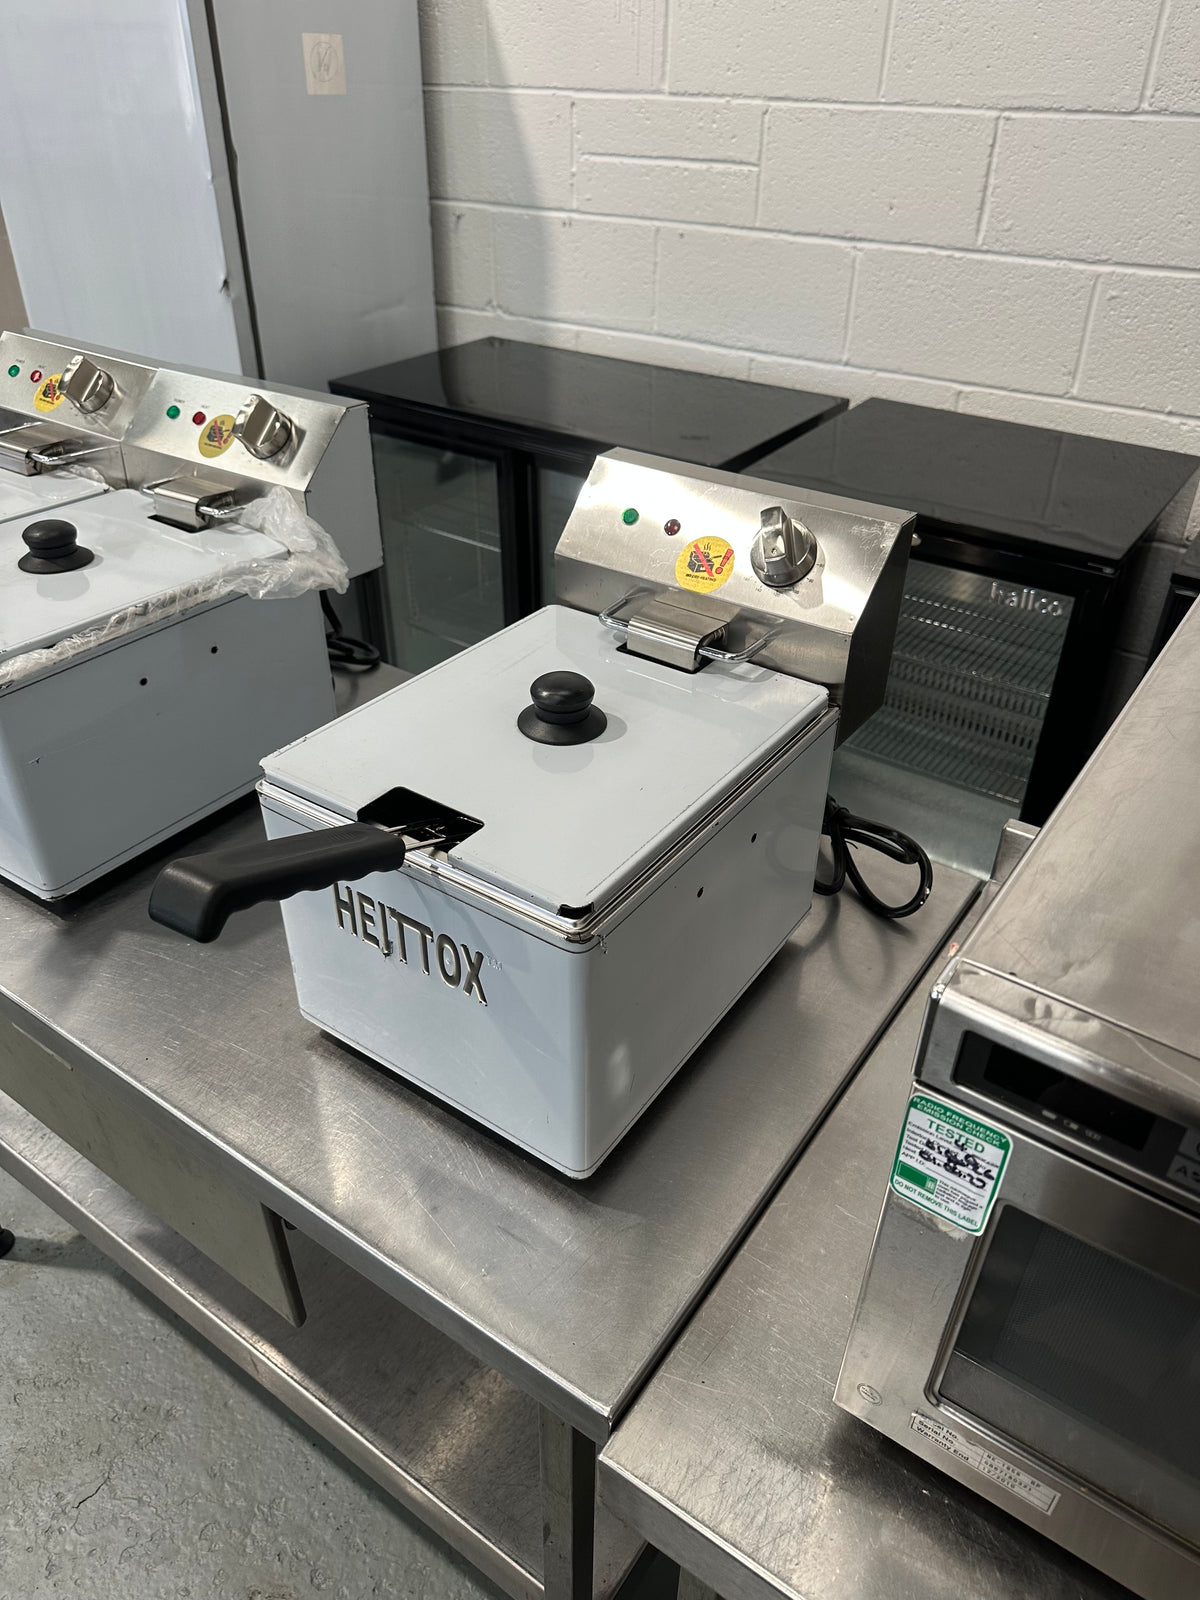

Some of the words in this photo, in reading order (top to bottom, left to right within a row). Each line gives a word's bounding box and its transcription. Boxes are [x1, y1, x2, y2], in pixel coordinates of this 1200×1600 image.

[913, 1096, 945, 1113] RADIO
[946, 1111, 1008, 1143] FREQUENCY
[916, 1104, 963, 1129] EMISSION
[965, 1127, 1001, 1147] CHECK
[927, 1118, 985, 1154] TESTED
[894, 1178, 904, 1188] DO
[904, 1183, 918, 1195] NOT
[917, 1190, 944, 1210] REMOVE
[944, 1205, 958, 1217] THIS
[958, 1213, 979, 1228] LABEL
[916, 1425, 952, 1451] Warranty
[953, 1449, 970, 1461] End
[918, 1420, 941, 1437] Serial
